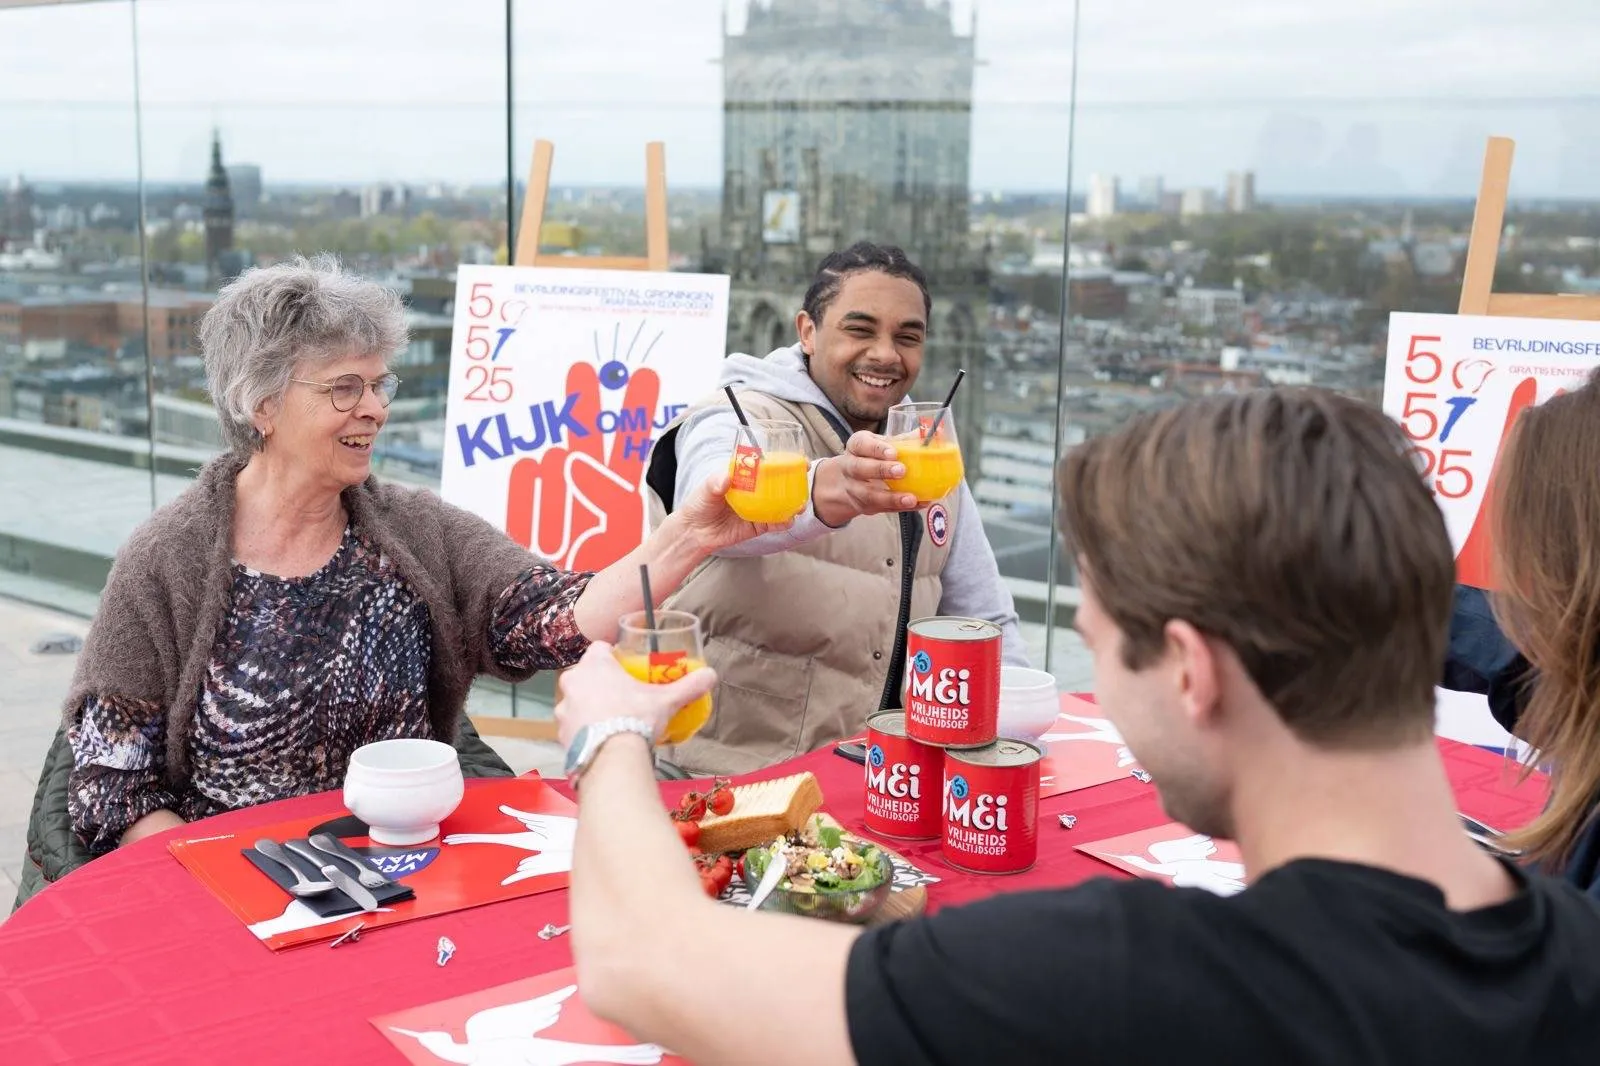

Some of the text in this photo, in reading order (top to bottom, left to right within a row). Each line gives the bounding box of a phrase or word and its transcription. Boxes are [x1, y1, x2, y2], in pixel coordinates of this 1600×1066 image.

[469, 283, 493, 319] 5
[465, 325, 490, 361] 5
[1404, 335, 1442, 384] 5
[1508, 365, 1549, 376] GRATIS
[464, 366, 513, 402] 25
[1401, 392, 1438, 440] 5
[456, 392, 589, 467] KIJK
[596, 406, 647, 433] OM
[916, 652, 928, 672] 5
[911, 700, 969, 720] VRIJHEIDS
[910, 712, 969, 730] MAALTIJDSOEP
[872, 746, 882, 766] 5
[954, 777, 965, 797] 5
[866, 803, 920, 822] MAALTIJDSOEP
[867, 791, 920, 814] VRIJHEIDS
[947, 823, 1007, 847] VRIJHEIDS
[947, 836, 1007, 856] MAALTIJDSOEP
